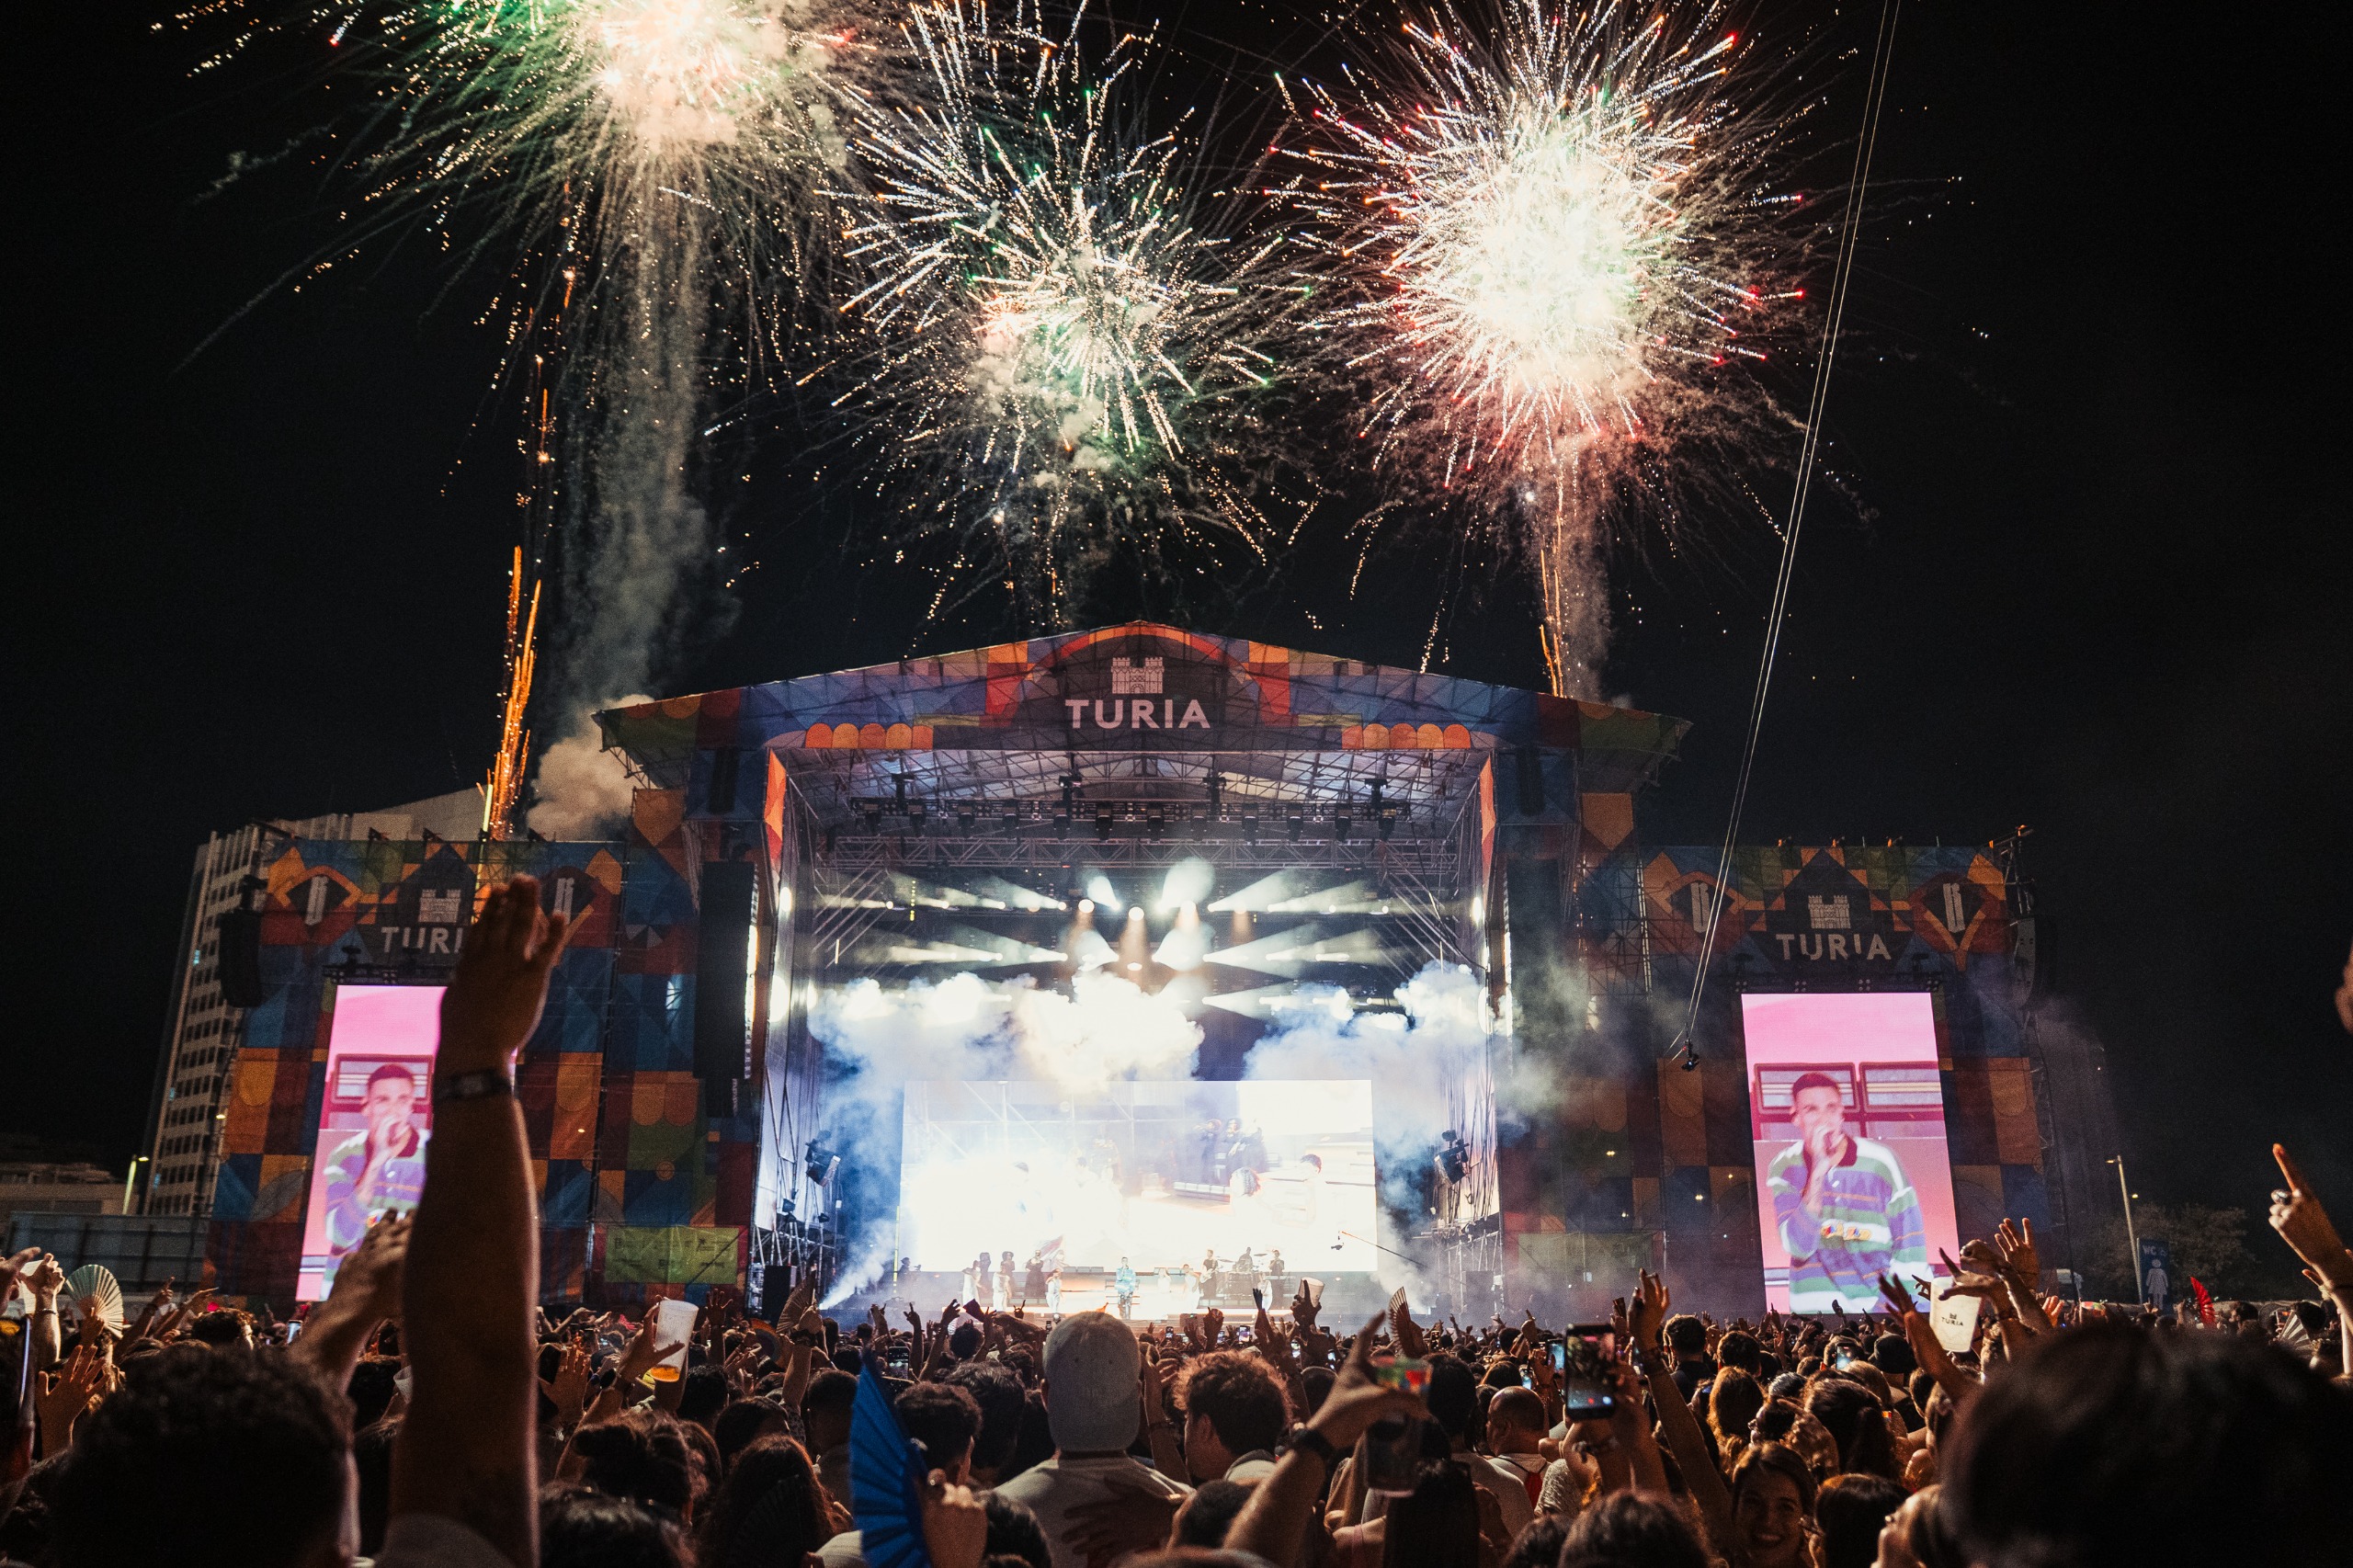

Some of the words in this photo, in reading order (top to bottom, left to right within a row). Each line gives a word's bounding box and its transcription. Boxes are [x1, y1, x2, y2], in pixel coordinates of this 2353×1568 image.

[1064, 699, 1211, 730] TURIA
[381, 926, 464, 954] TURI
[1775, 933, 1892, 960] TURIA
[2143, 1244, 2157, 1256] WC
[1941, 1317, 1963, 1326] TURIA
